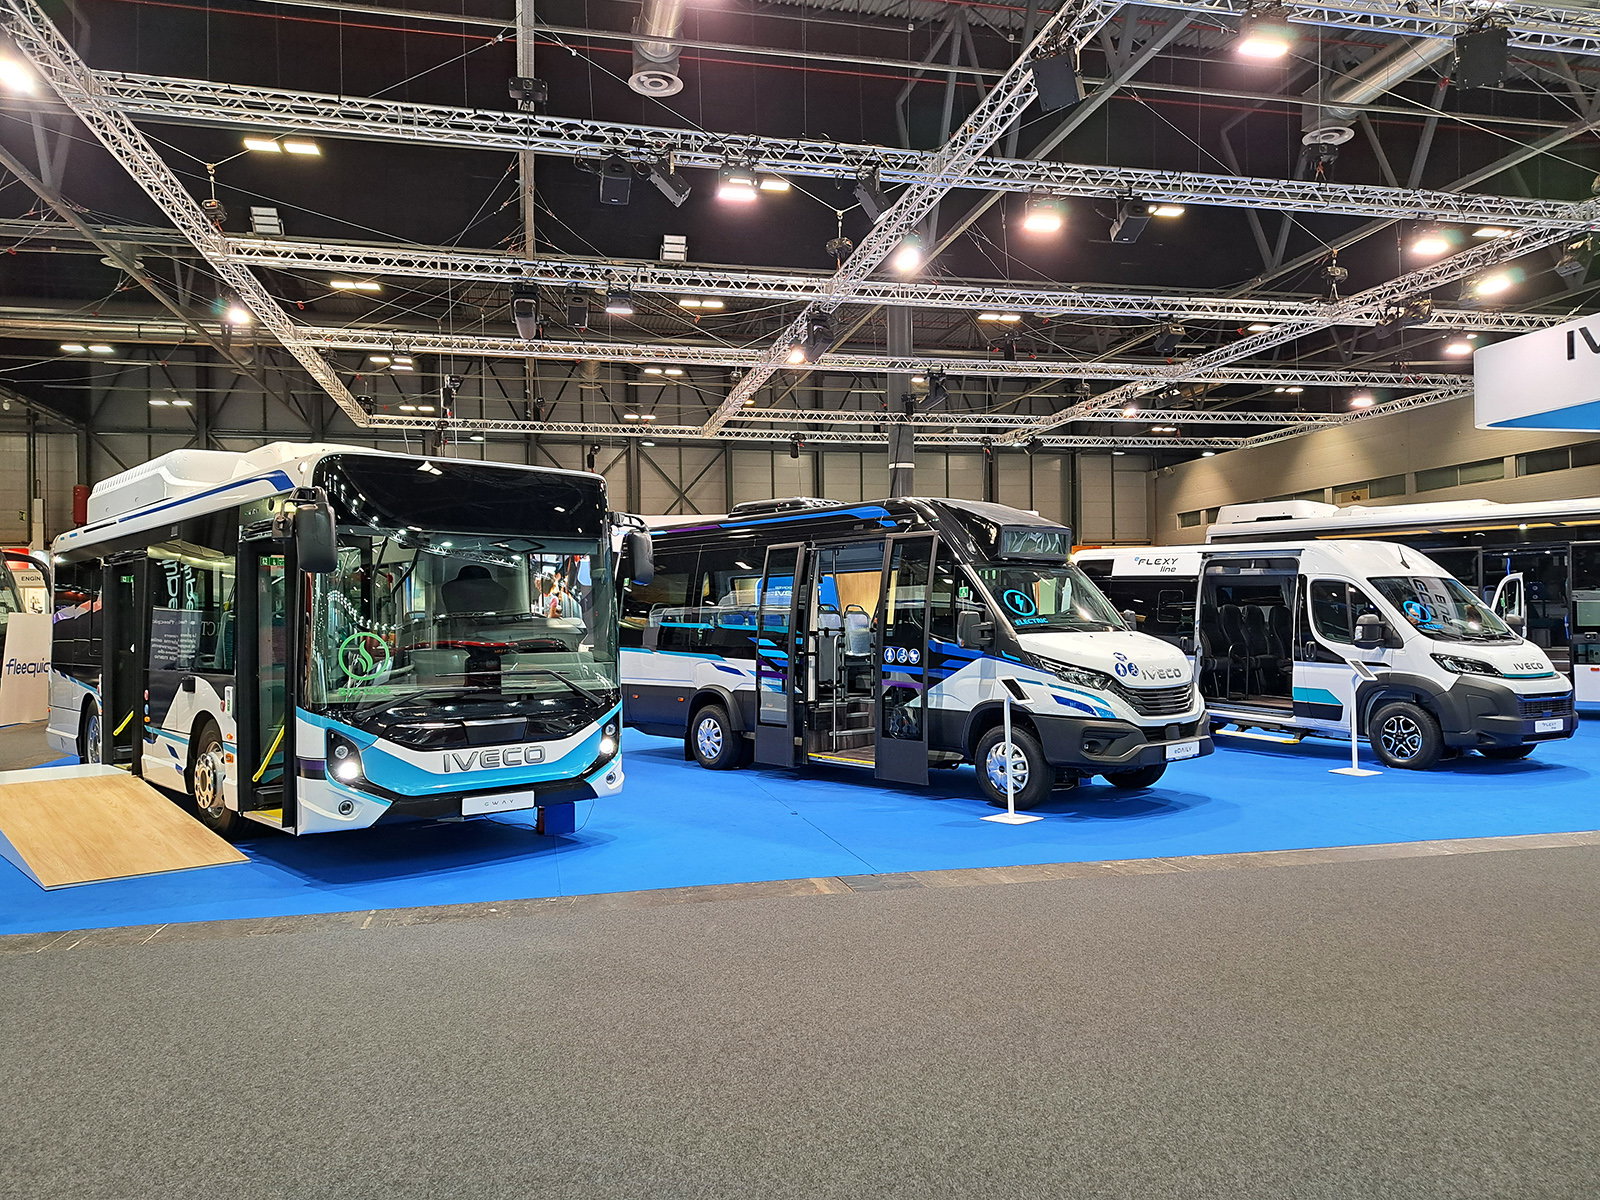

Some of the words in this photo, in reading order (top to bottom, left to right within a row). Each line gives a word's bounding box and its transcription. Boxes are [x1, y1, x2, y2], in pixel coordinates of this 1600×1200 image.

[1014, 617, 1049, 627] ELECTRIC
[1513, 662, 1544, 671] IVECO
[1141, 668, 1182, 680] IVECO
[443, 745, 546, 773] IVECO
